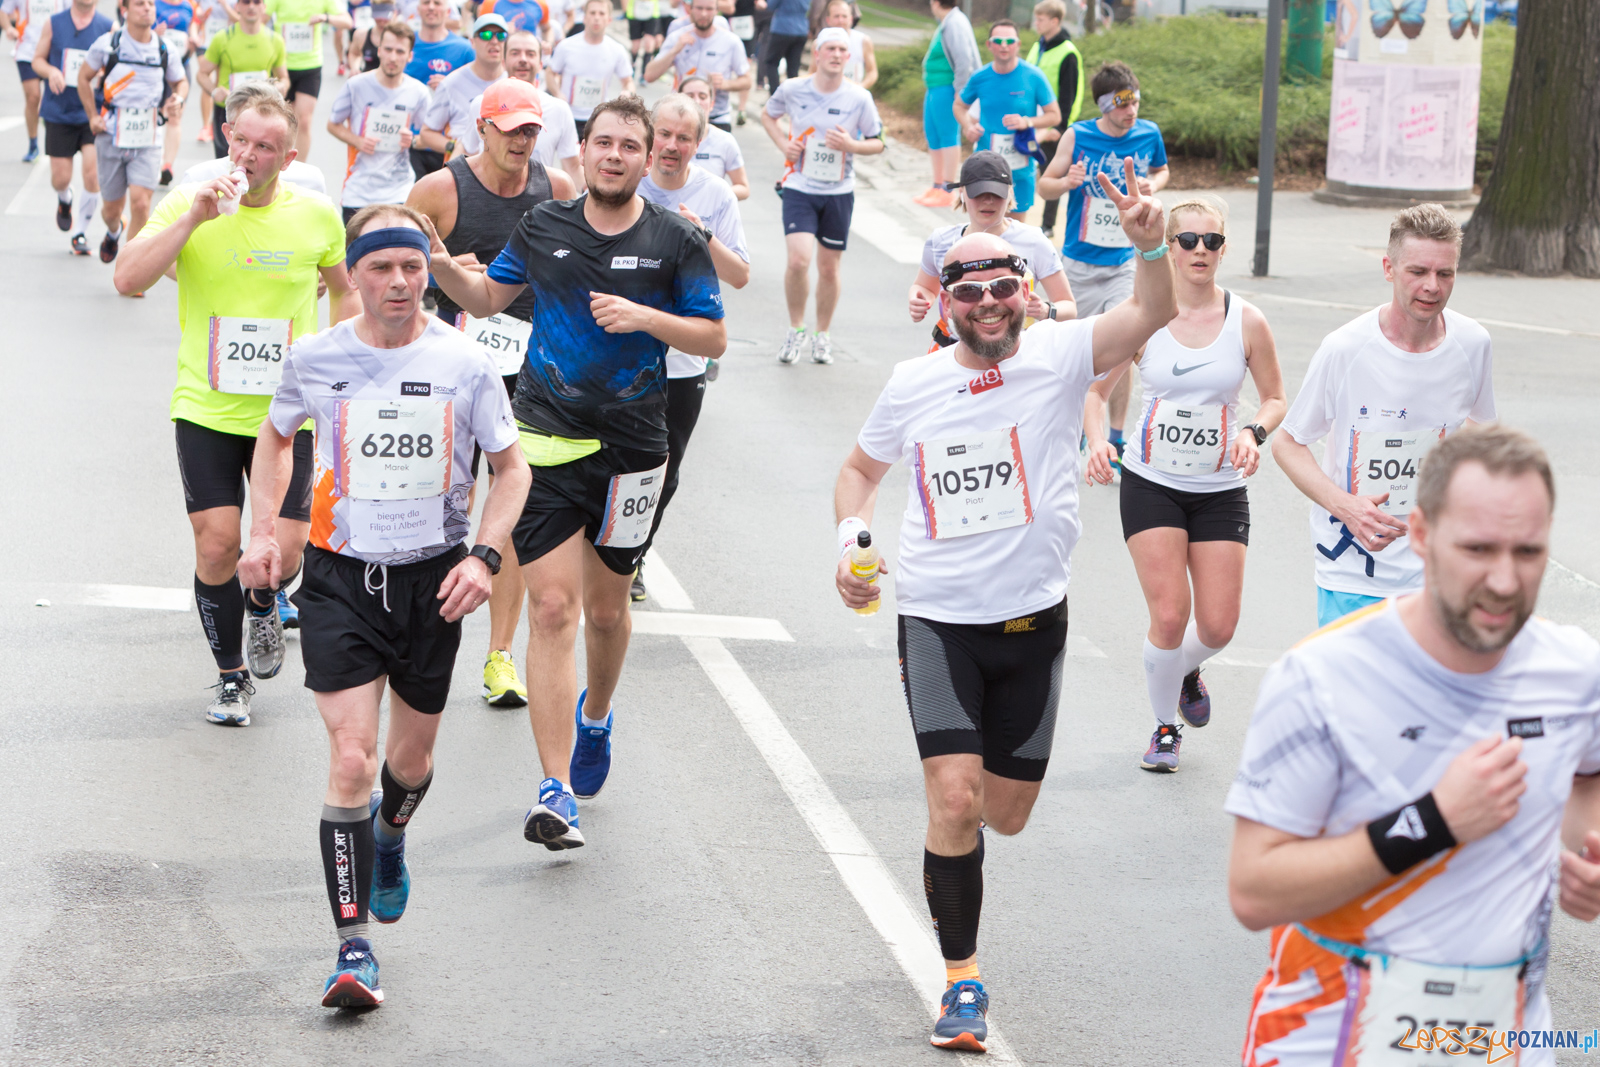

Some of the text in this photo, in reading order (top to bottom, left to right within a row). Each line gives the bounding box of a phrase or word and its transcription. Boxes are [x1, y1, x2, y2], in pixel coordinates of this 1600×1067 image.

[372, 122, 401, 134] 3867
[813, 151, 835, 163] 398
[553, 249, 571, 258] 4F
[476, 330, 520, 352] 4571
[227, 341, 282, 362] 2043
[331, 381, 349, 392] 4F
[414, 385, 429, 393] PKO
[1158, 424, 1219, 446] 10763
[361, 433, 434, 458] 6288
[1171, 447, 1200, 455] Charlotte
[931, 461, 1013, 496] 10579
[622, 487, 661, 517] 804
[965, 497, 984, 505] Piotr
[377, 510, 420, 522] biegnę dla
[369, 519, 427, 532] Filipa i Alberta
